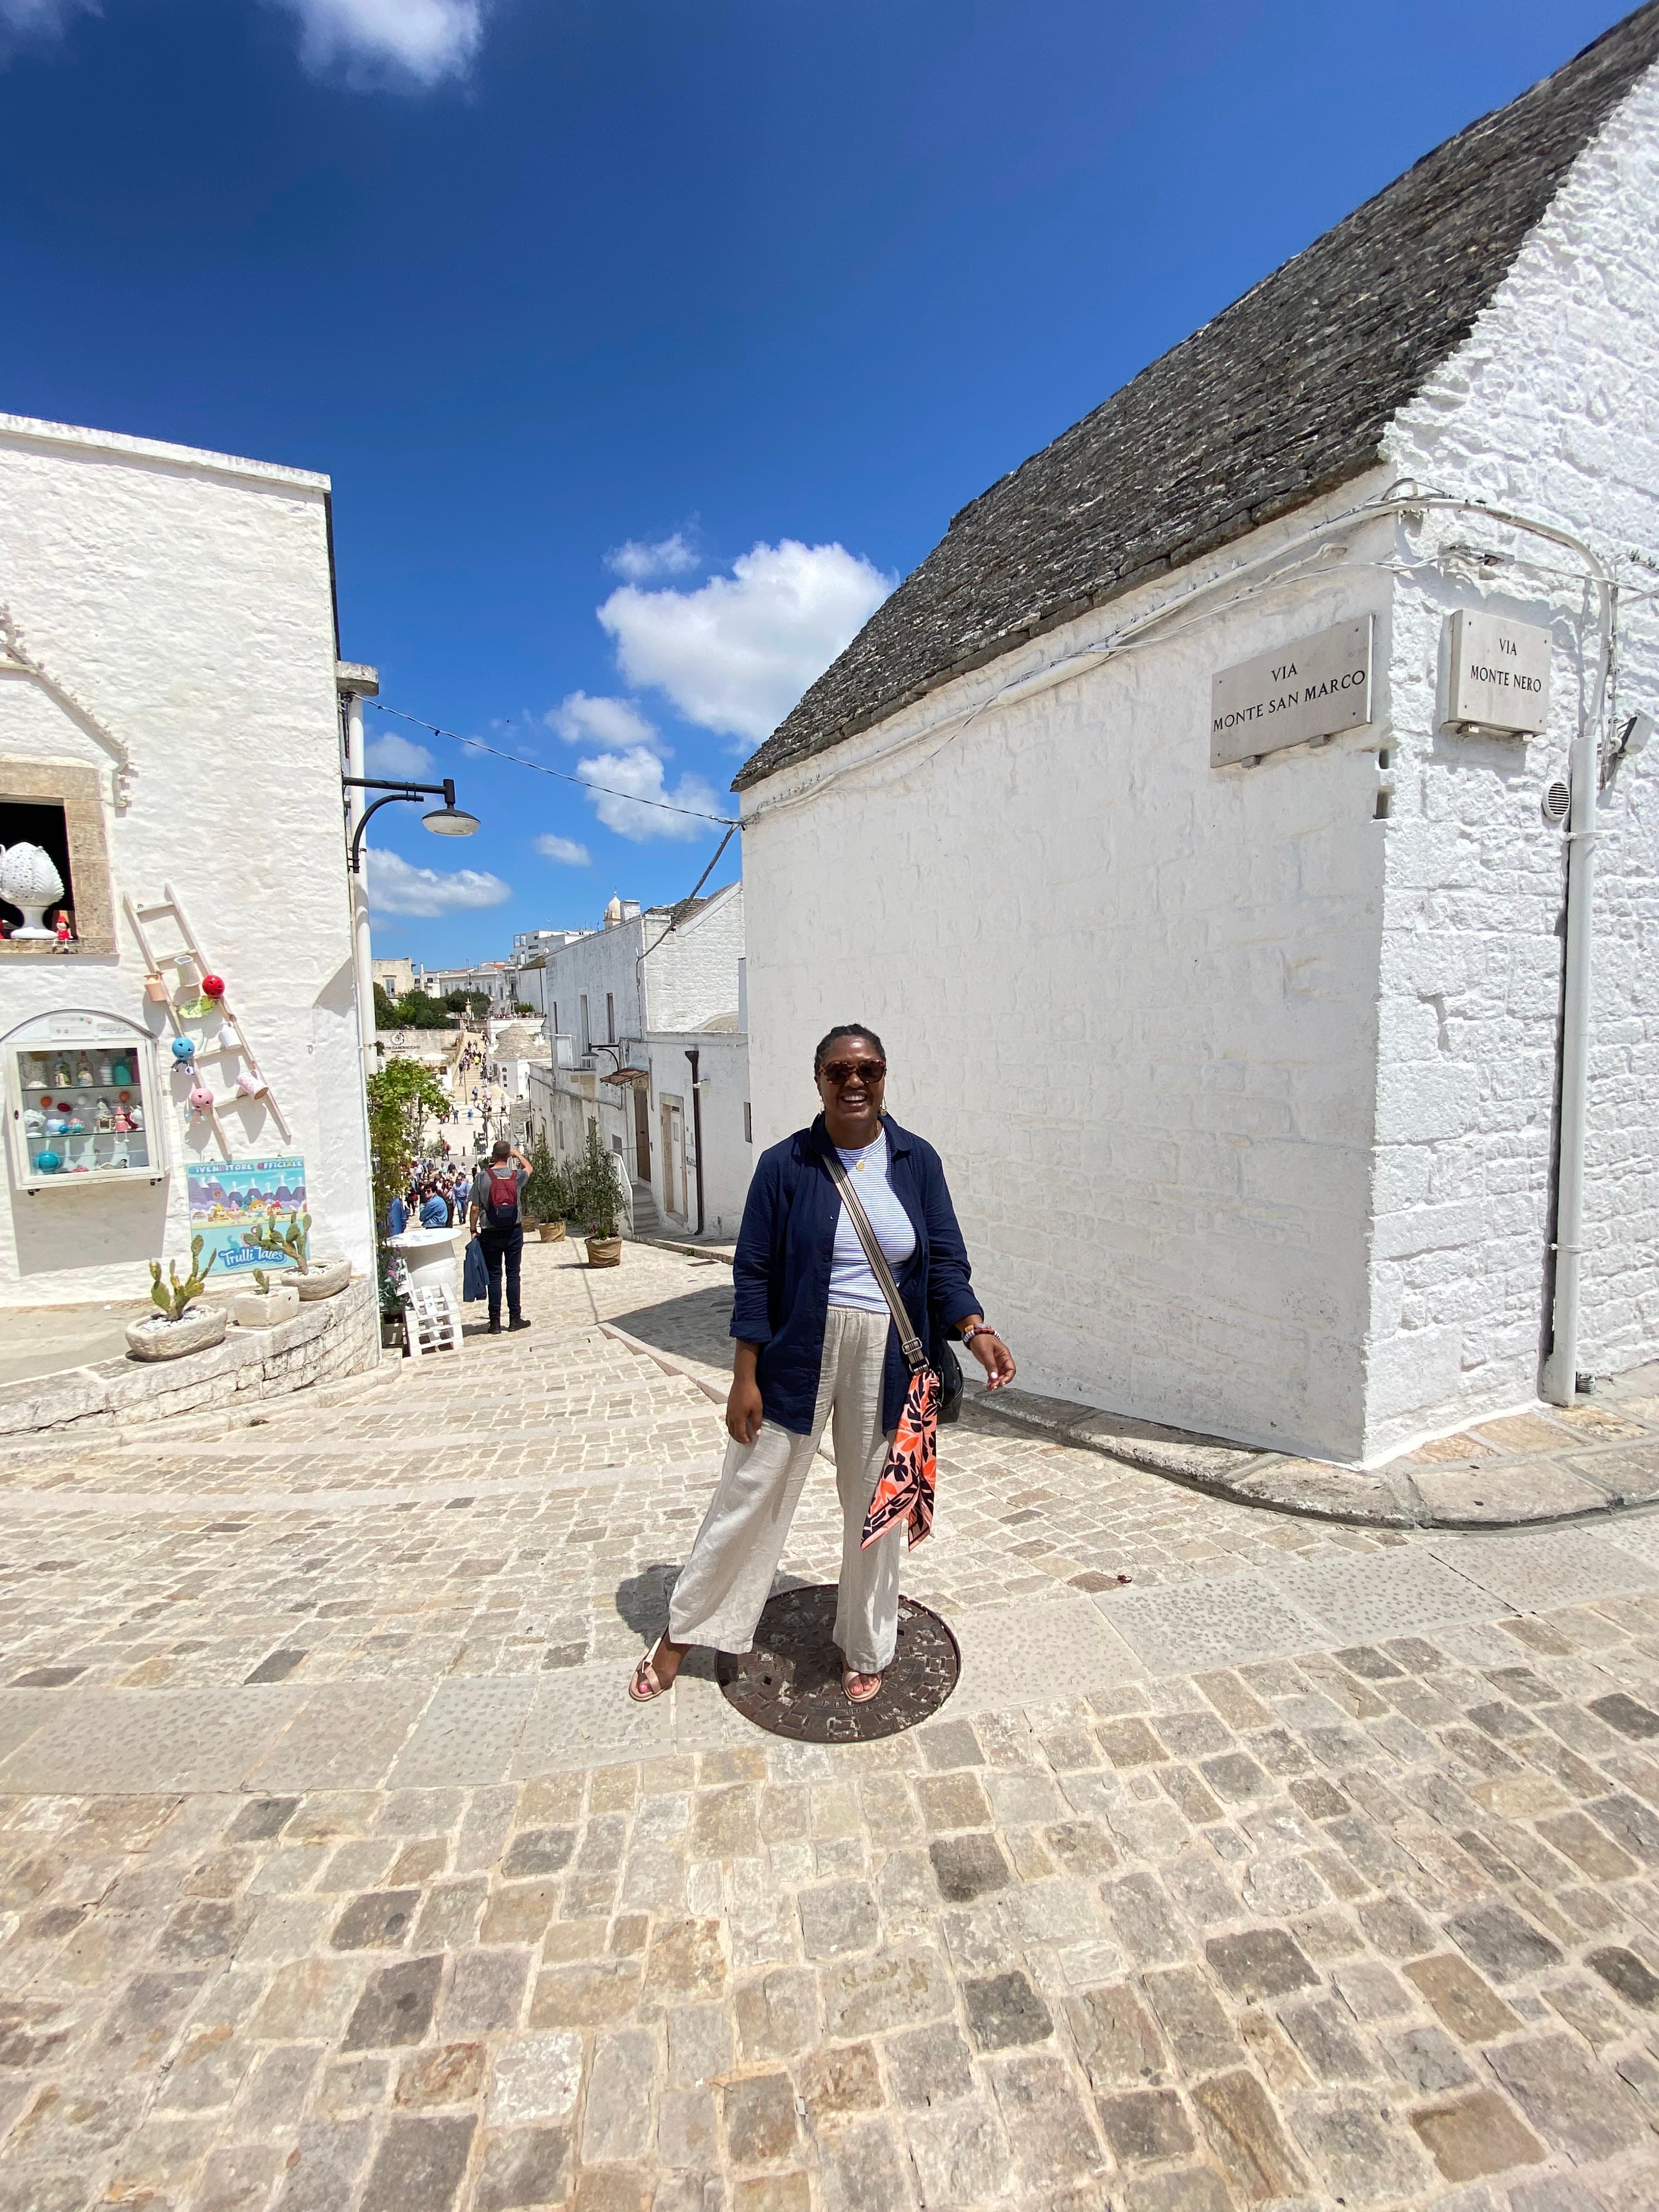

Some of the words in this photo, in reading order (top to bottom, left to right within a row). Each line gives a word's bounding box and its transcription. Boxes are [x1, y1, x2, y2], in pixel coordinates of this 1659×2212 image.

[1499, 639, 1517, 656] VIA
[1271, 662, 1298, 682] VIA
[1470, 665, 1509, 686] MONTE
[1514, 674, 1542, 692] NERO
[1213, 703, 1263, 732] MONTE
[1268, 691, 1299, 713] SAN
[1304, 670, 1365, 702] MARCO
[189, 1164, 252, 1173] IVENDITORE
[221, 1249, 254, 1265] Trulli
